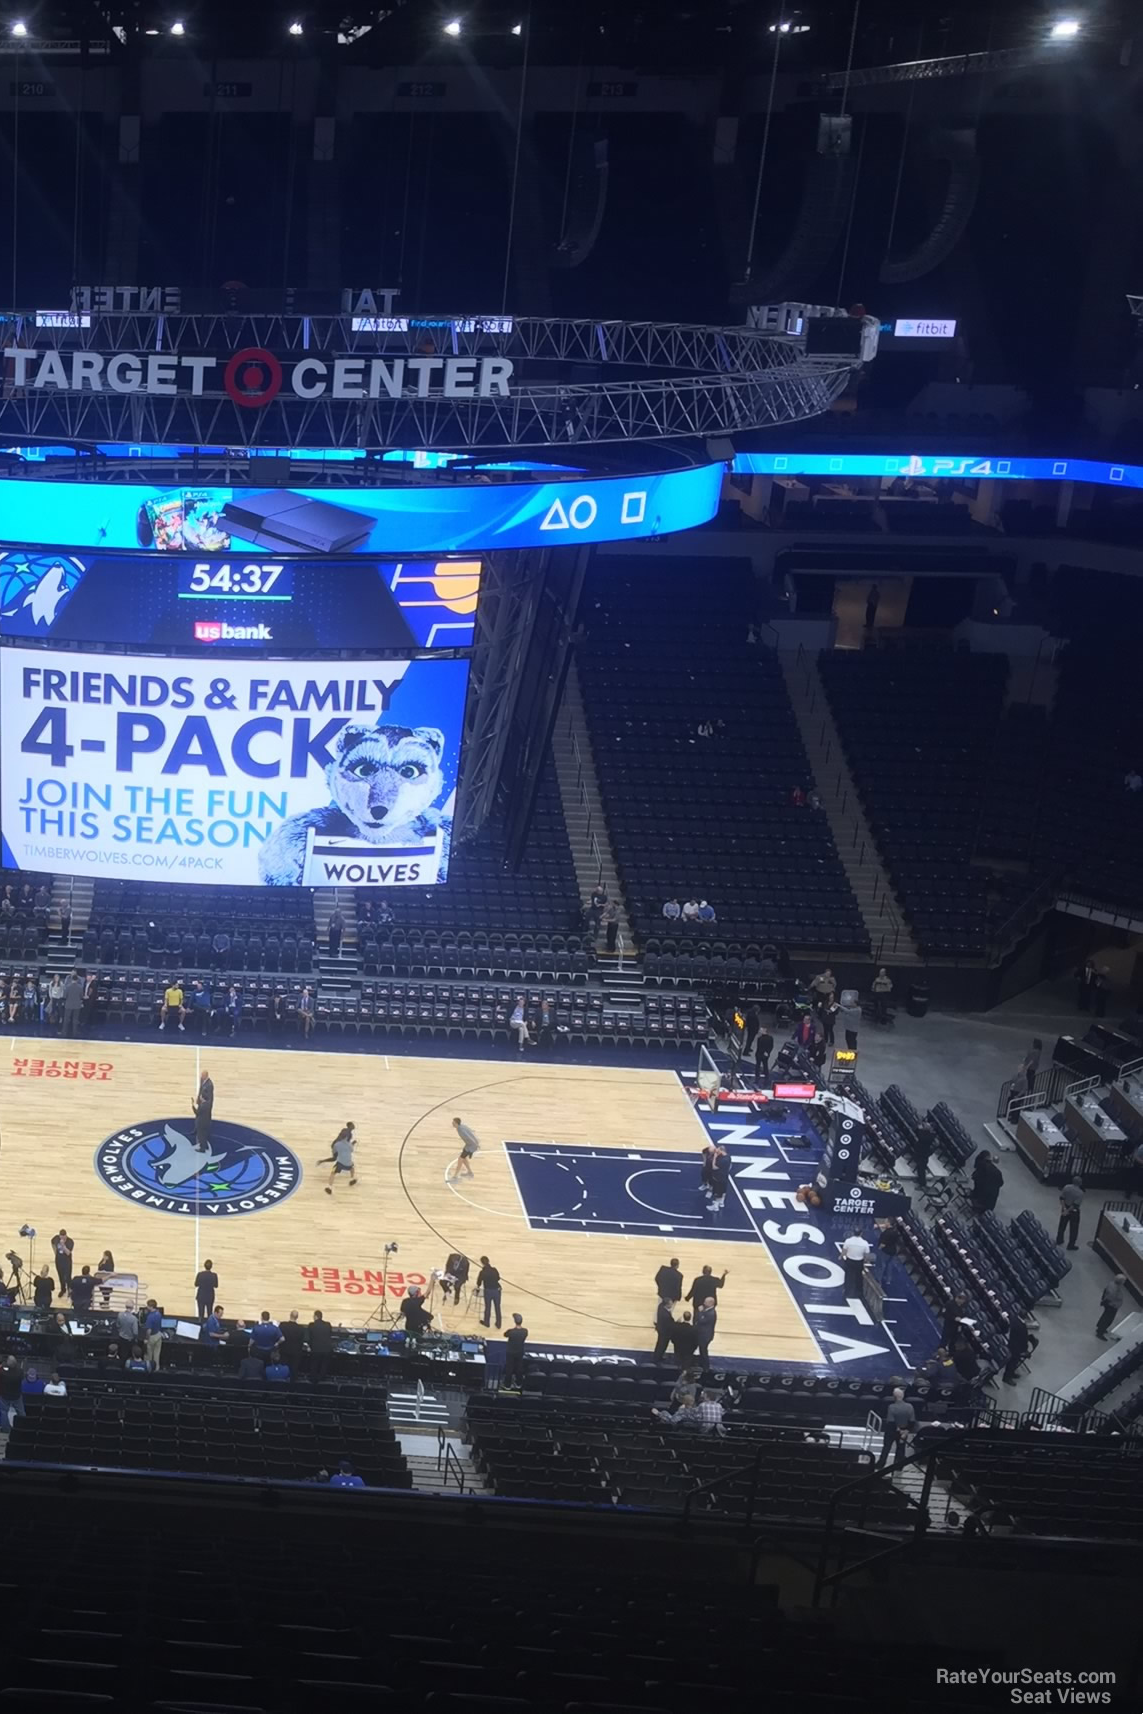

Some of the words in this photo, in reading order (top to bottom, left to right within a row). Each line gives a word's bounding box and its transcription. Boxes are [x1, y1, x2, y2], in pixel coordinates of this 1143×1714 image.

[22, 83, 44, 95] 210
[217, 84, 237, 95] 211
[410, 85, 433, 95] 212
[601, 84, 624, 96] 213
[916, 322, 949, 335] fitbit
[4, 347, 216, 396] TARGET
[291, 357, 514, 399] CENTER
[932, 459, 993, 474] PS4
[189, 563, 284, 593] 54:37
[22, 667, 194, 708] FRIENDS
[203, 677, 238, 711] &
[248, 679, 404, 712] FAMILY
[20, 706, 353, 779] 4-PACK
[19, 777, 112, 808] JOIN
[124, 785, 194, 817] THE
[206, 789, 288, 819] FUN
[19, 806, 100, 840] THIS
[112, 814, 273, 849] SEASON
[23, 844, 224, 871] TIMBERWOLVES.COM/4PACK
[323, 862, 420, 884] WOLVES
[10, 1067, 113, 1081] TARGET
[13, 1058, 114, 1072] CENTER
[102, 1128, 191, 1214] TIMBERWOLVES
[206, 1153, 294, 1214] MINNESOTA
[833, 1205, 874, 1215] CENTER
[834, 1198, 876, 1208] TARGET
[300, 1266, 427, 1286] CENTER
[301, 1280, 407, 1298] ARGET
